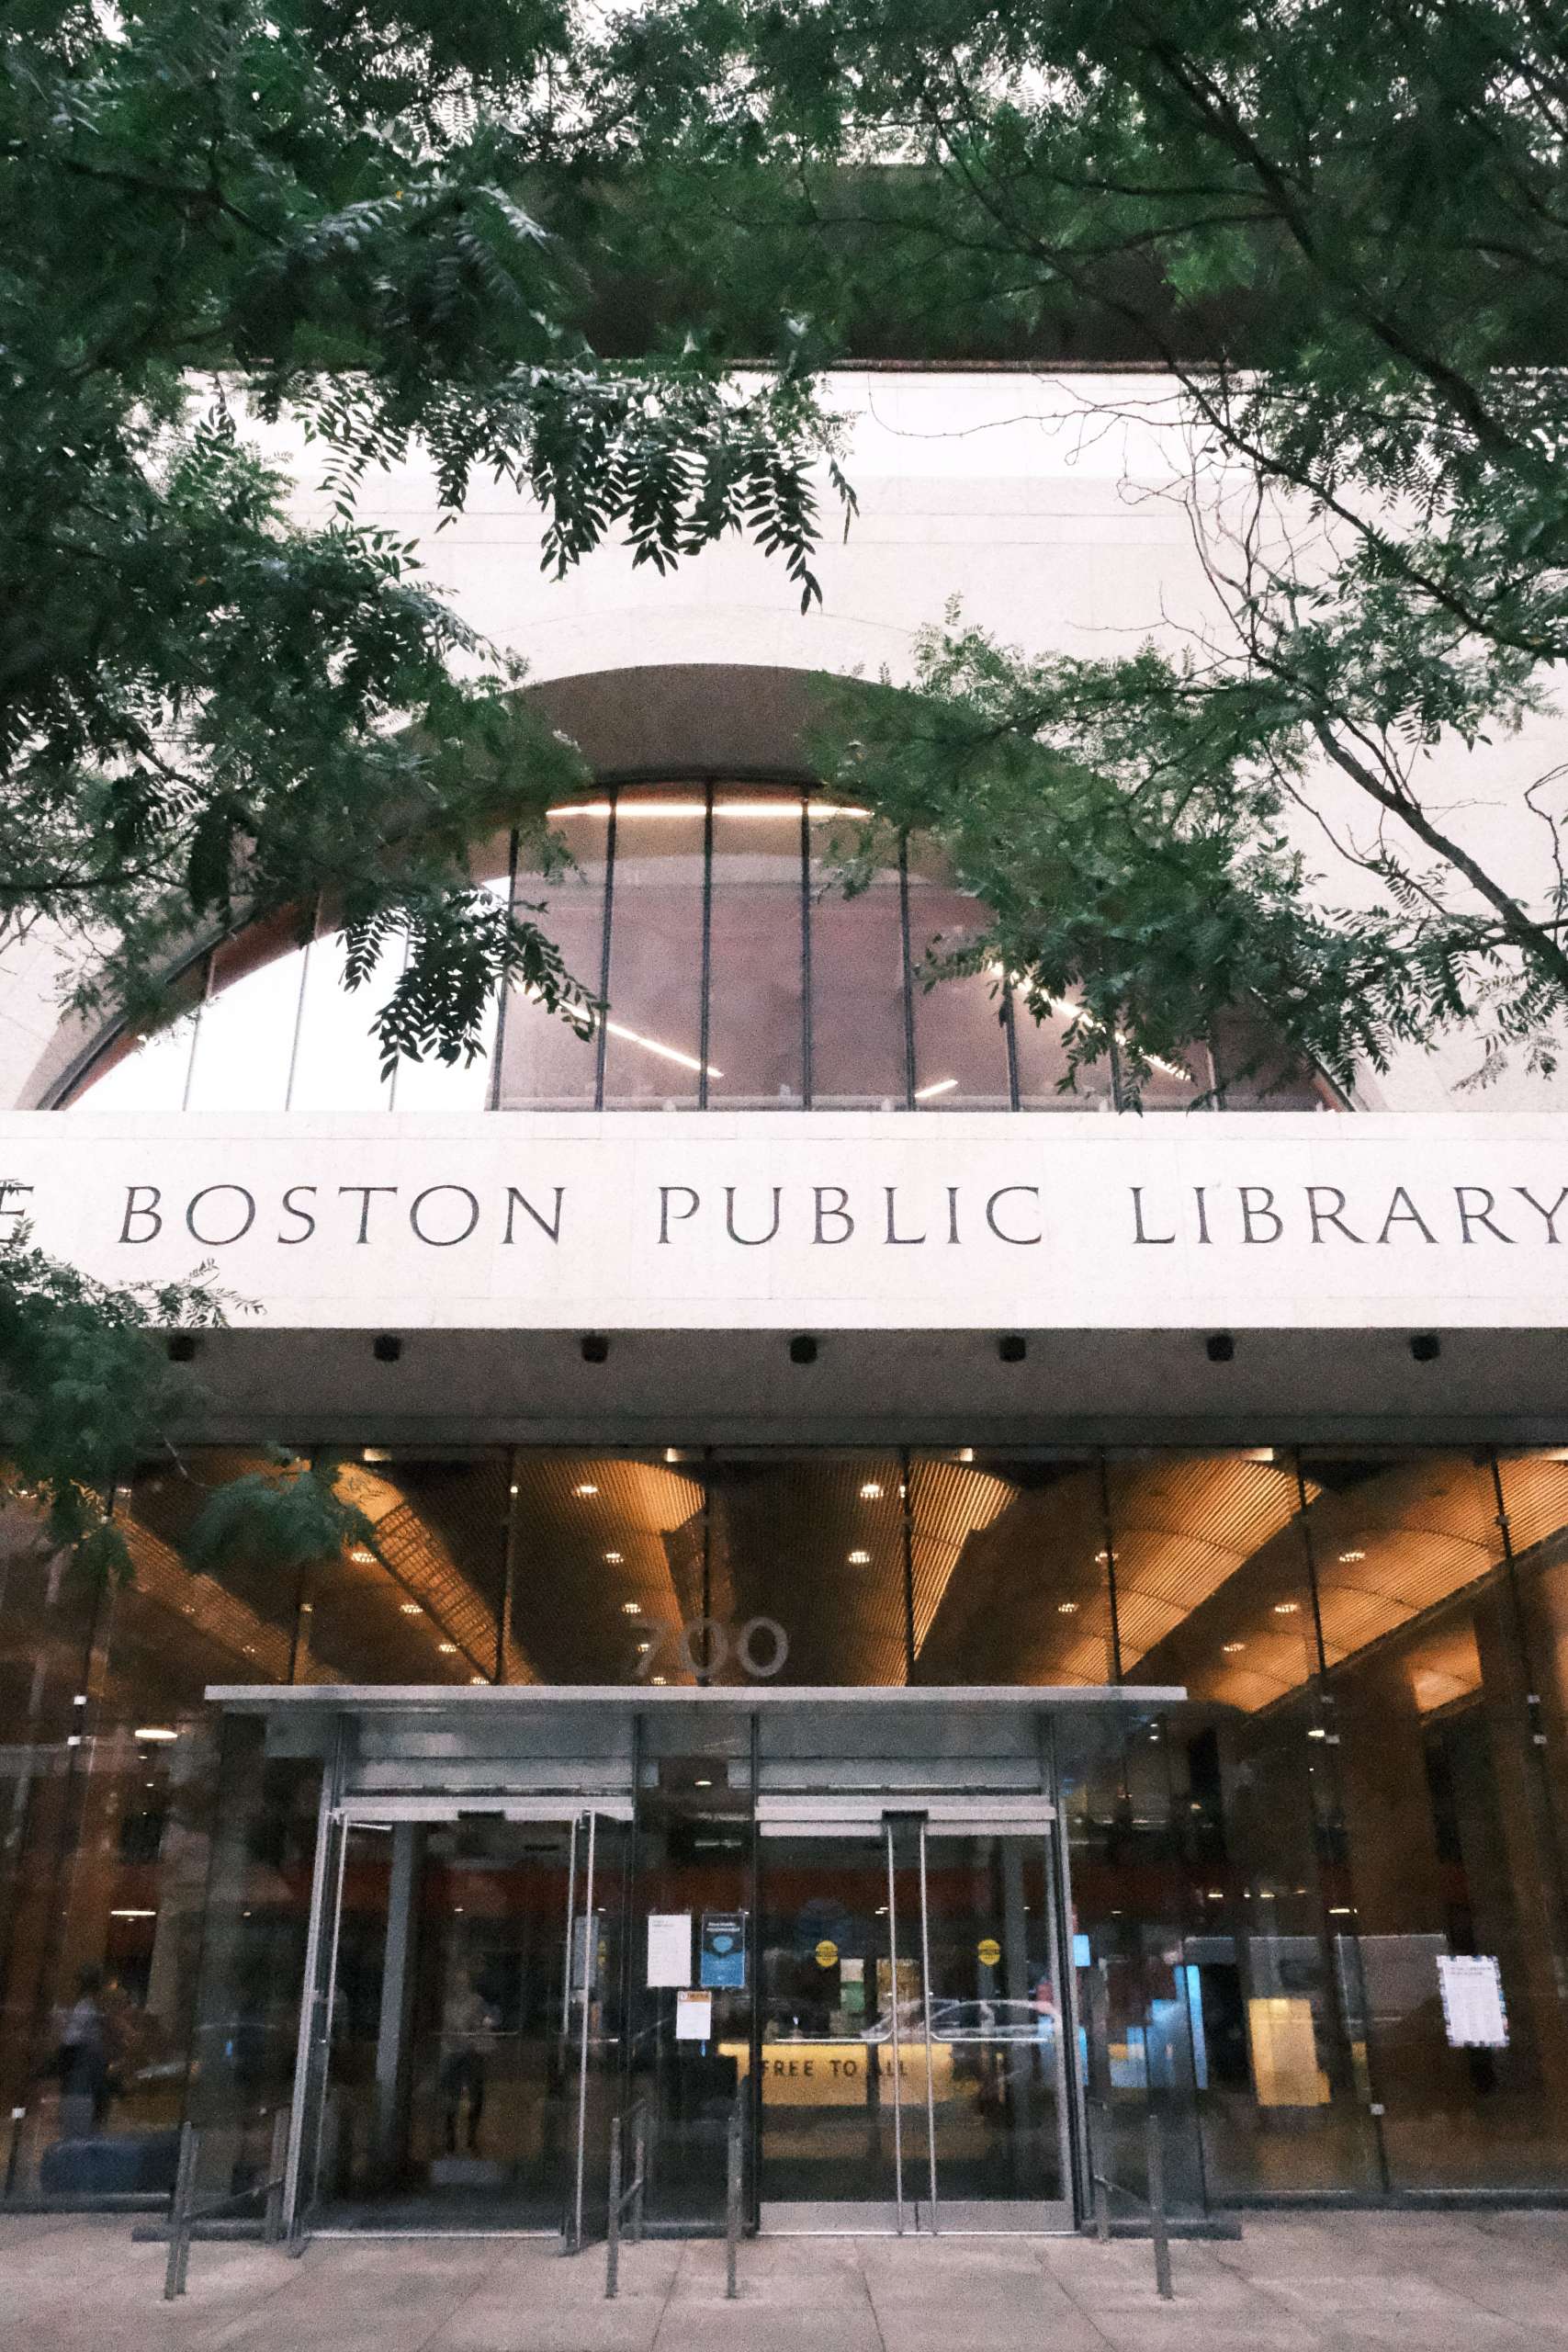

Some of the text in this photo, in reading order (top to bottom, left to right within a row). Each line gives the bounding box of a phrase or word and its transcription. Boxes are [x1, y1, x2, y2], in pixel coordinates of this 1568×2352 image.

[118, 1184, 567, 1246] BOSTON
[656, 1185, 1043, 1246] PUBLIC
[1129, 1186, 1568, 1245] LIBRARY
[631, 1616, 788, 1677] 700
[761, 2060, 908, 2077] FREE TO LL
